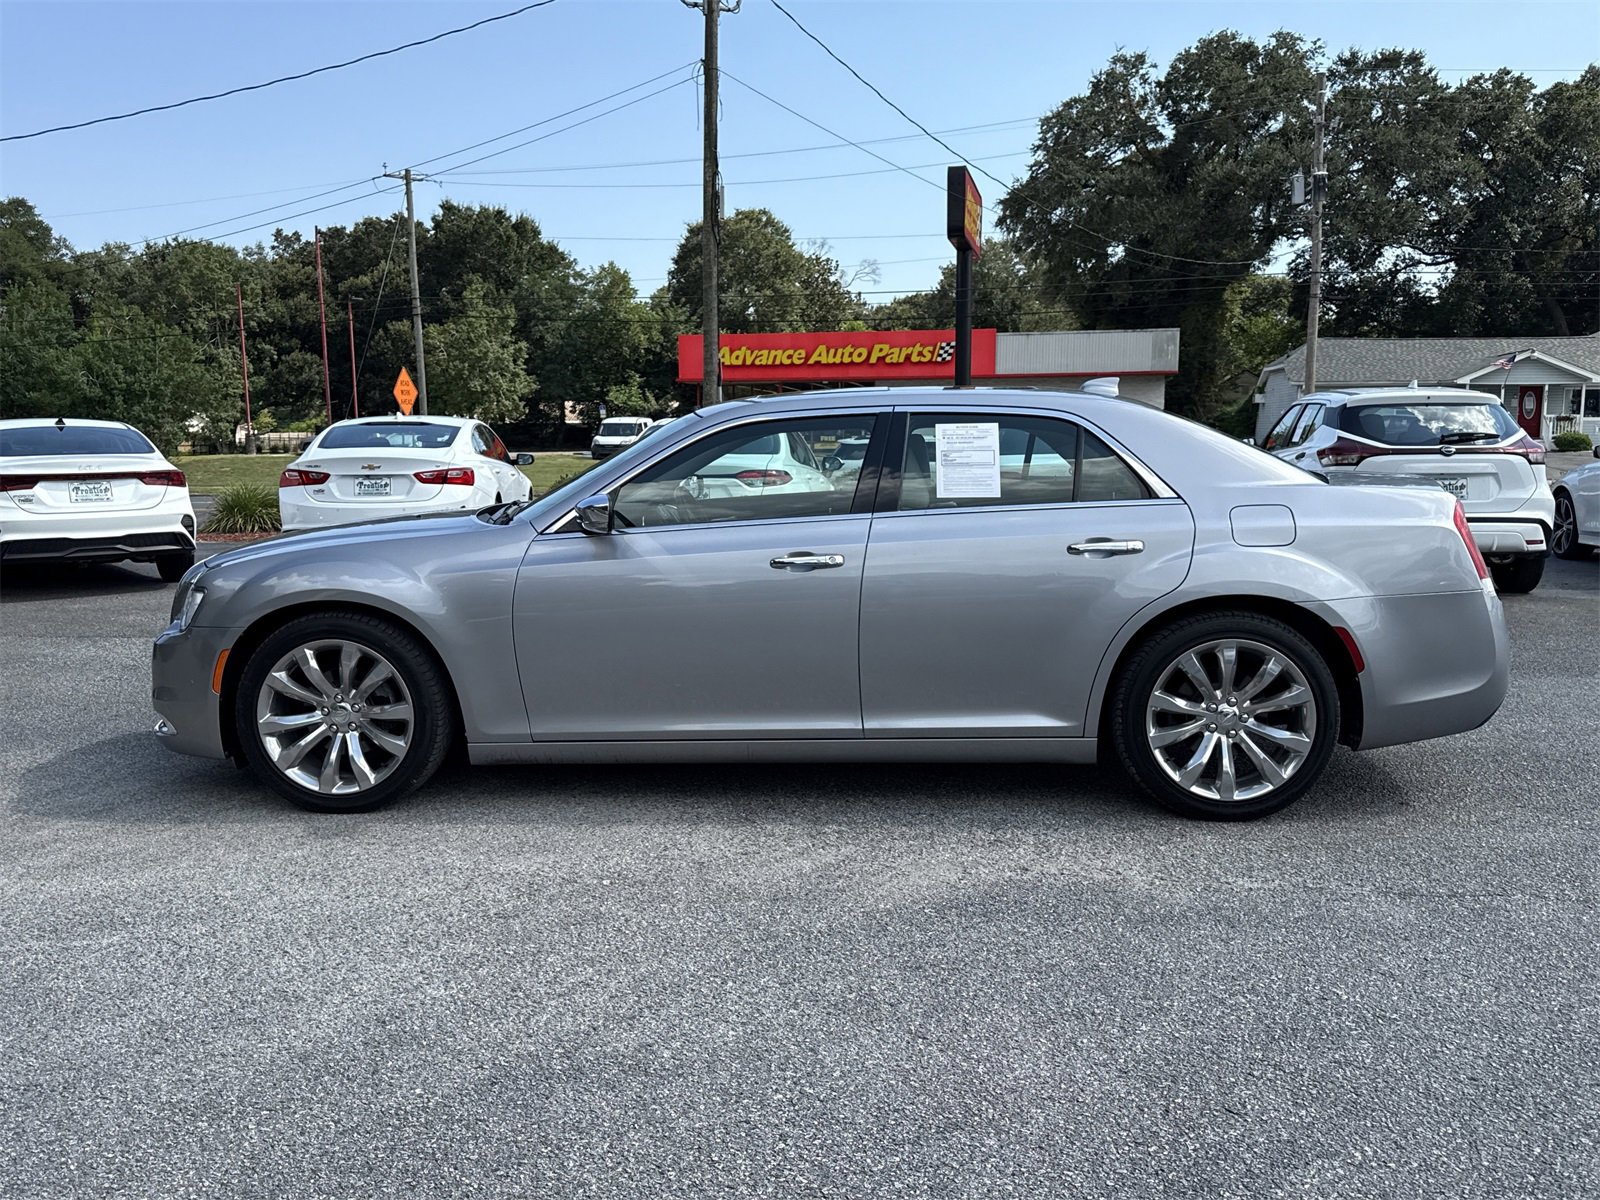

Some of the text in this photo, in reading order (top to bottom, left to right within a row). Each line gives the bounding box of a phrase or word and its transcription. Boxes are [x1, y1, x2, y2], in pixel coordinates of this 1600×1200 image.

[719, 342, 934, 366] Advance Auto Parts
